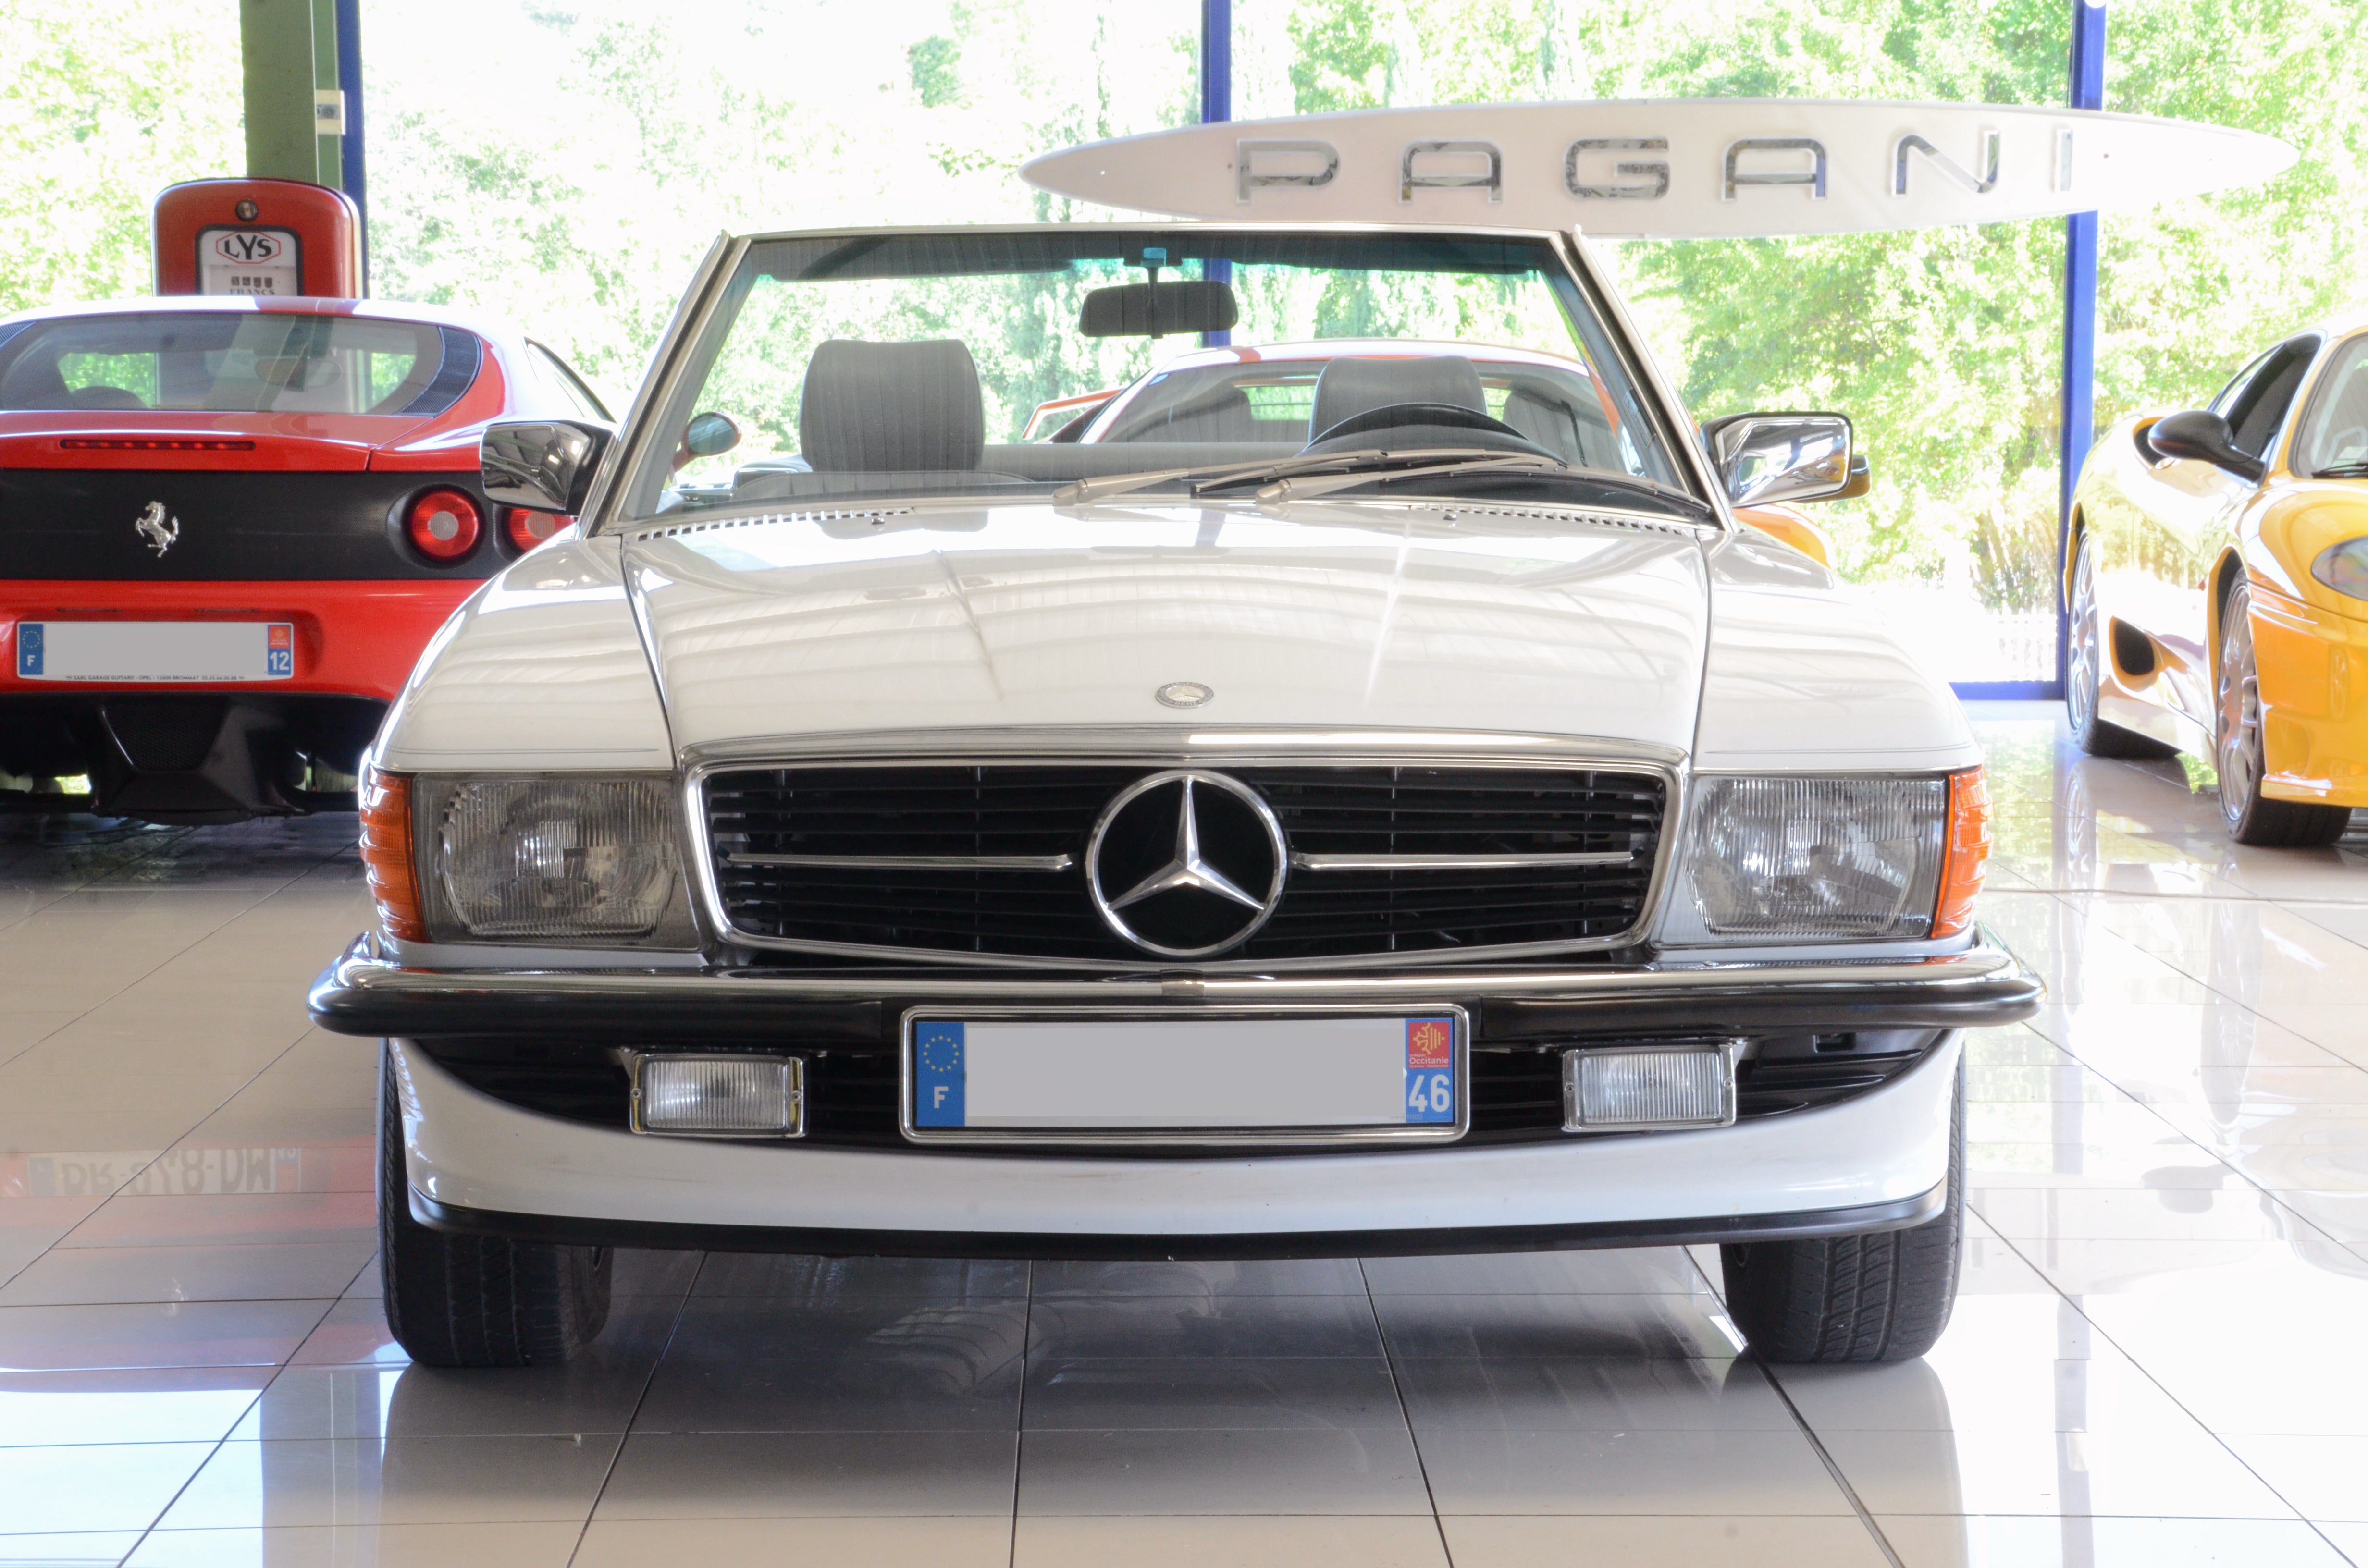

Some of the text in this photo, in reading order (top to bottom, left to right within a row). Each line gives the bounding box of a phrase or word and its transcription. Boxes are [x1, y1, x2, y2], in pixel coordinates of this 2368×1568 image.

[1237, 129, 2073, 204] PAGANI
[224, 234, 272, 260] LYS
[27, 655, 35, 666] F
[270, 651, 290, 670] 12
[933, 1085, 949, 1109] F
[1408, 1074, 1450, 1113] 46
